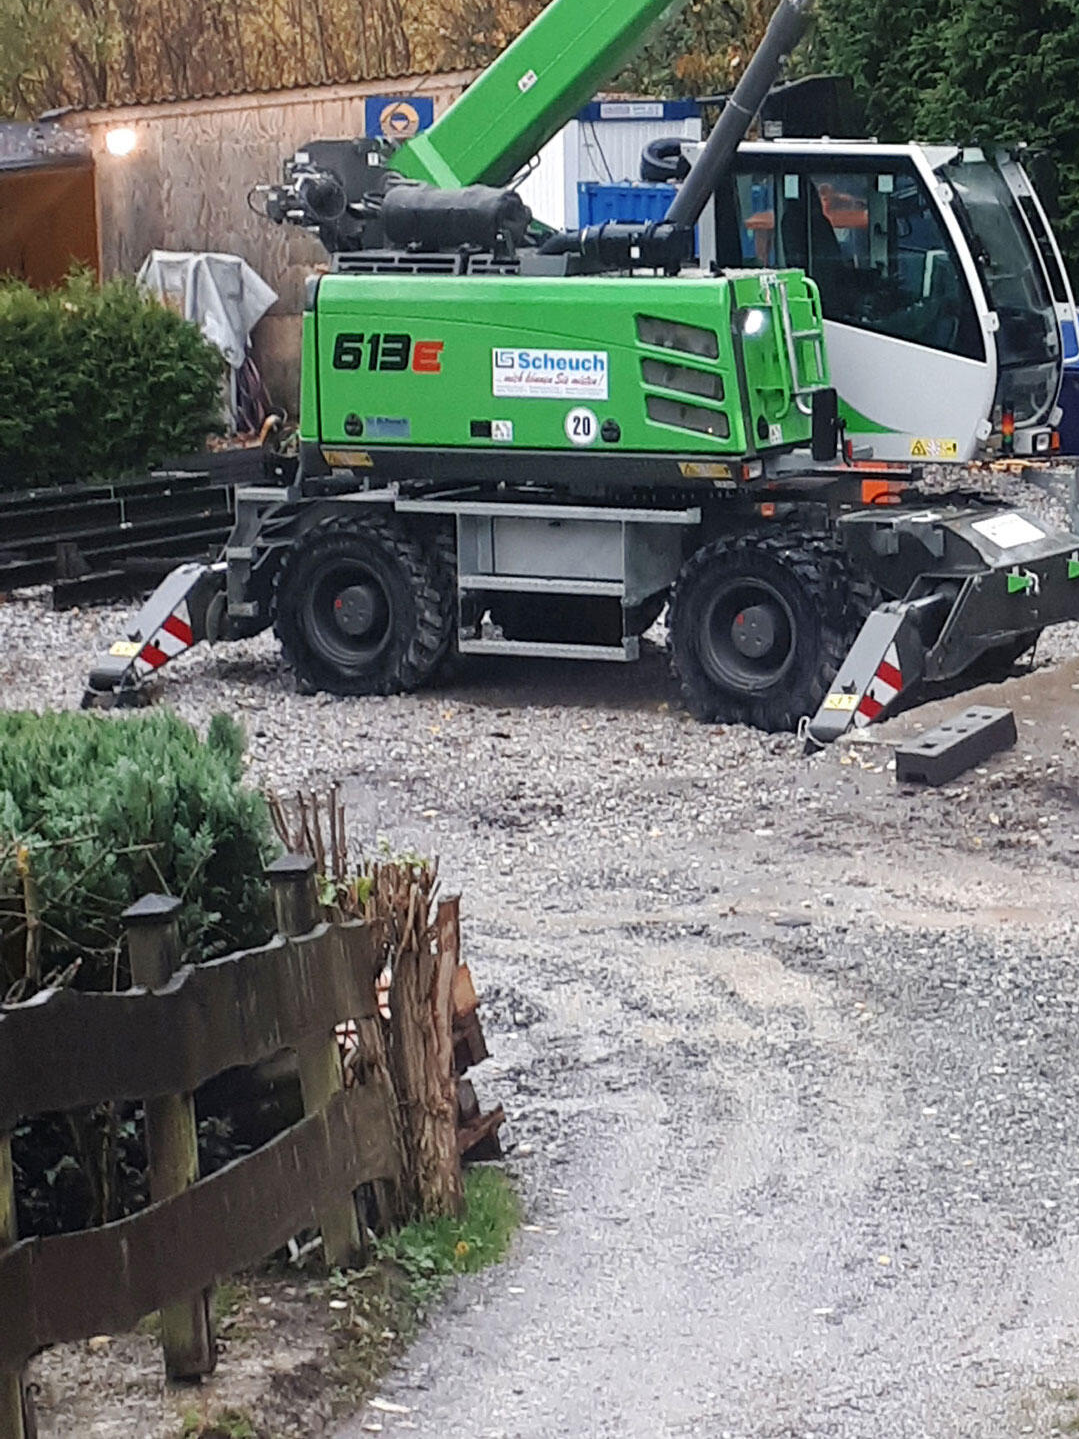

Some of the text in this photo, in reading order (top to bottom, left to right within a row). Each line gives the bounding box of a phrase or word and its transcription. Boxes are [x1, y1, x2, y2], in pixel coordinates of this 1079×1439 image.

[333, 333, 444, 371] 613E
[518, 352, 605, 371] Scheuch
[573, 416, 590, 435] 20
